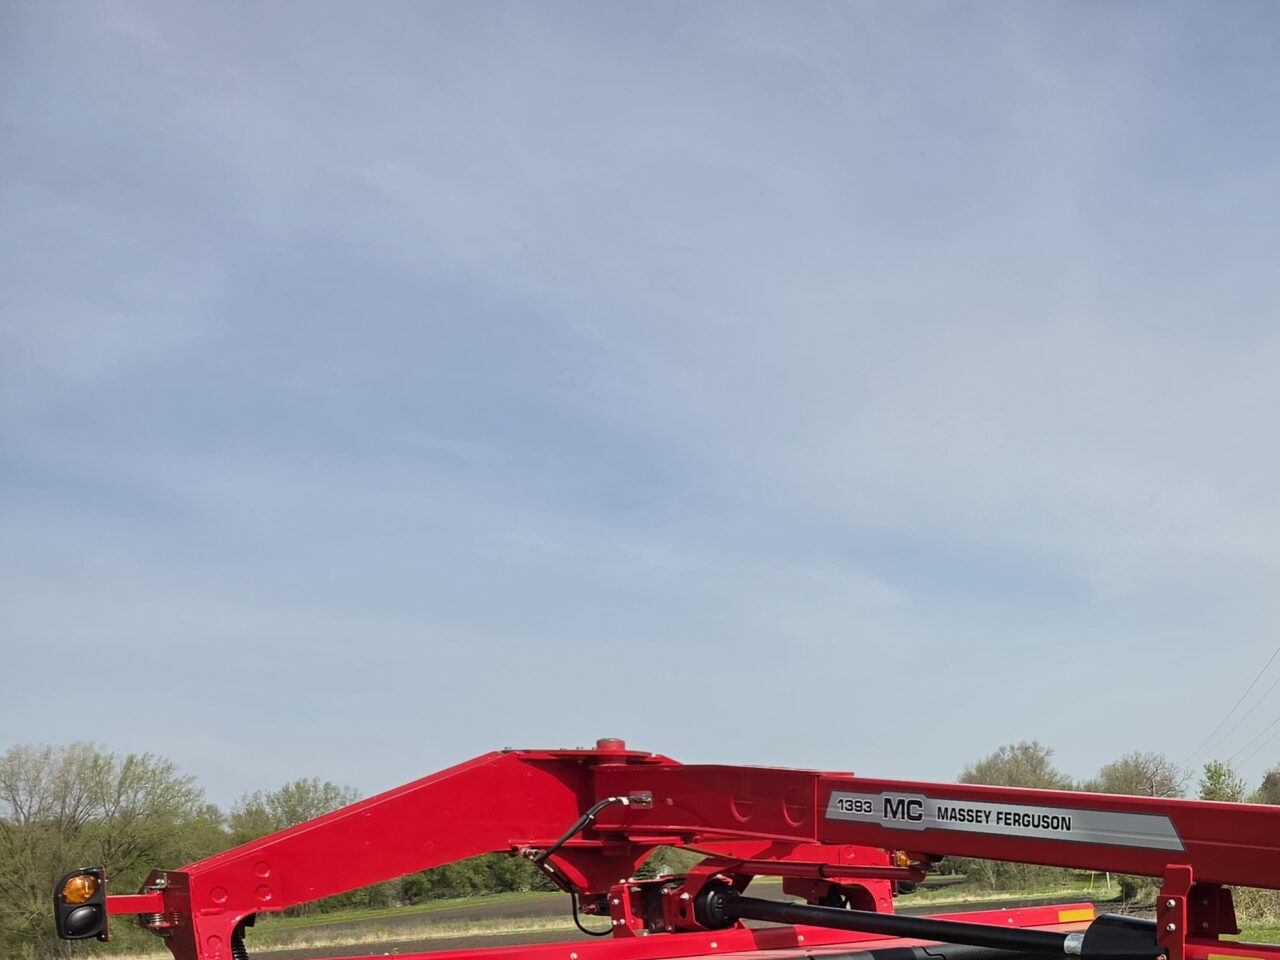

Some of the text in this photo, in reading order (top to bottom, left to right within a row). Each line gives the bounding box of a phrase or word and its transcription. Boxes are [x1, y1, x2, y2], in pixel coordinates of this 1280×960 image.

[837, 797, 1072, 832] 1393 MC MASSEY FERGUSON
